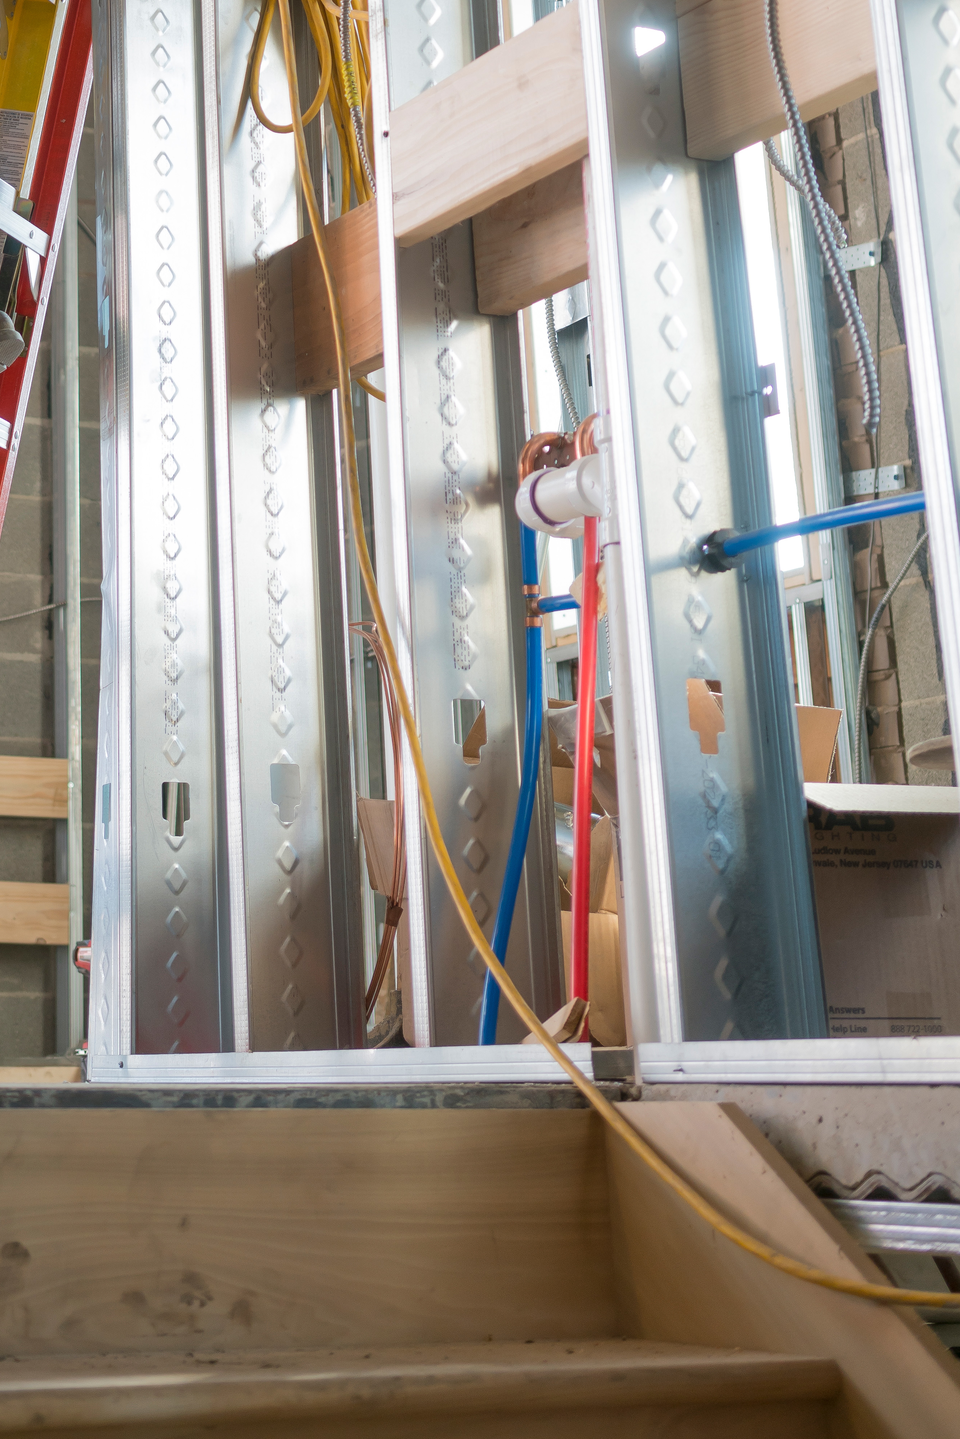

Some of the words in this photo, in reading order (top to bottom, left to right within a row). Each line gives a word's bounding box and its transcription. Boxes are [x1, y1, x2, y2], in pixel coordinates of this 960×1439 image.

[814, 832, 898, 842] GHTING
[812, 847, 841, 855] udlow
[844, 847, 876, 855] Avenue
[840, 860, 860, 868] New
[862, 860, 891, 870] Jersey
[921, 860, 942, 869] USA
[829, 1006, 866, 1014] Answers
[850, 1025, 867, 1033] Line
